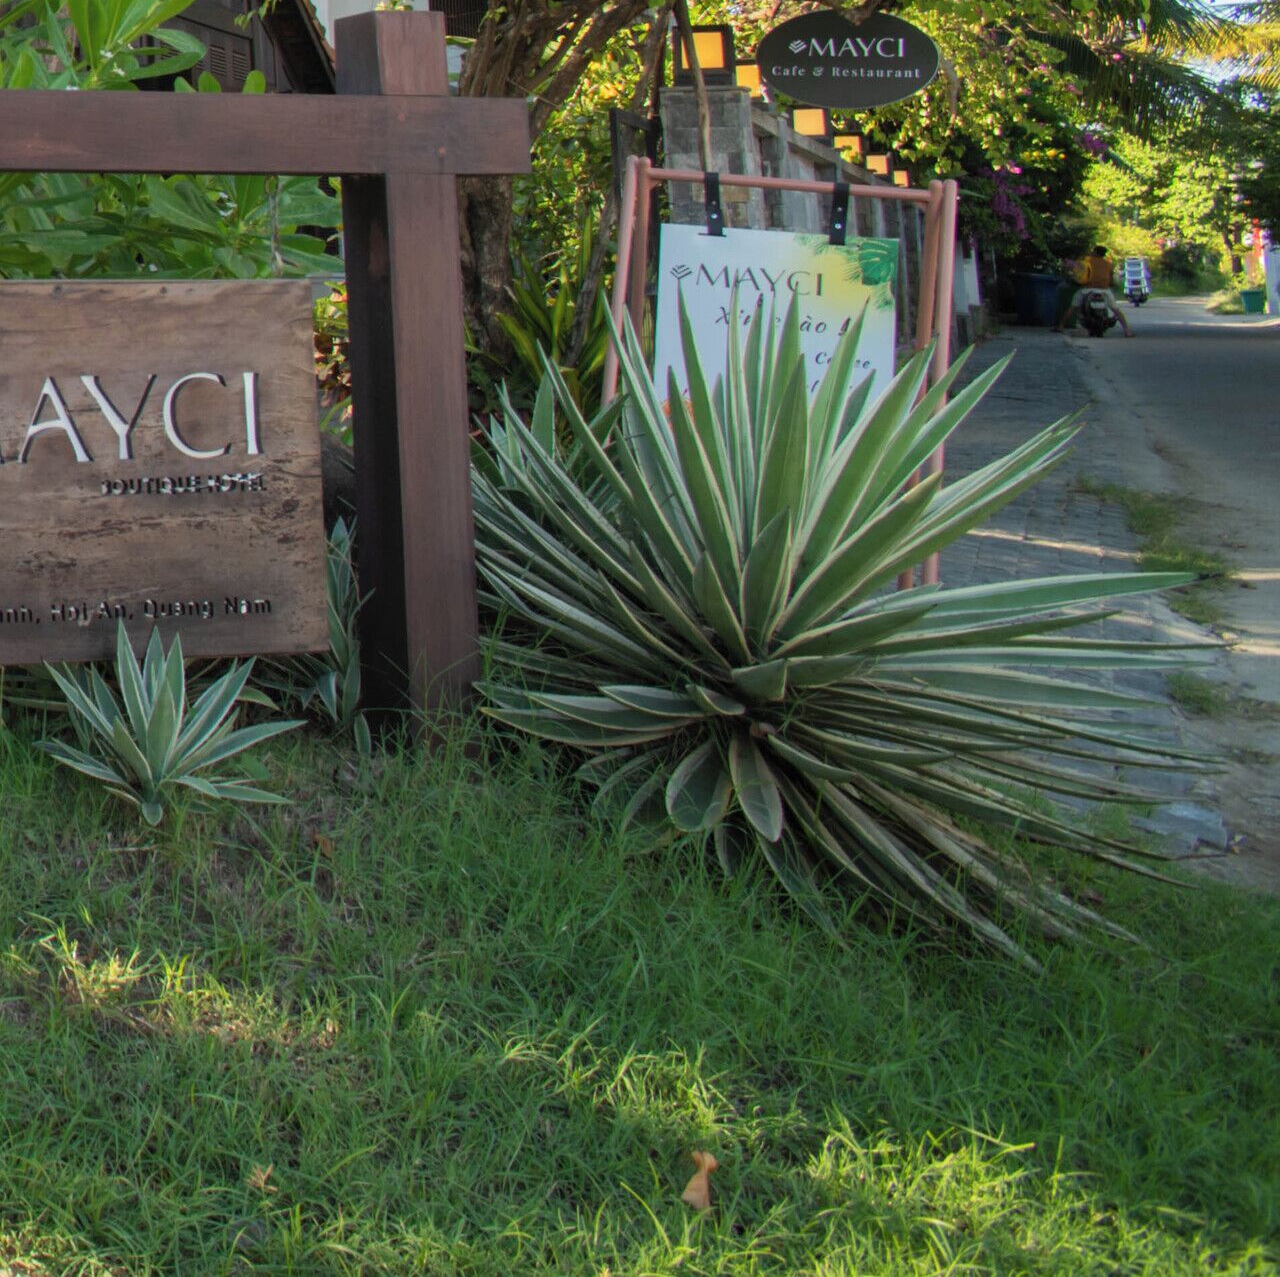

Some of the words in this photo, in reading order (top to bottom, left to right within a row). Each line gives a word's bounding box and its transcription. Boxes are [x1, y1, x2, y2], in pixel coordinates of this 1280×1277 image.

[808, 37, 906, 58] MAYCI
[772, 66, 806, 77] Cafe
[813, 66, 824, 77] &
[832, 67, 921, 79] Restaurant
[696, 263, 823, 296] MAYCI
[101, 475, 201, 495] BOUTIQUE
[207, 473, 267, 492] HOTEL
[51, 602, 89, 622] Hoi
[98, 601, 134, 620] An,
[143, 599, 215, 619] Quang
[224, 596, 272, 615] Nam
